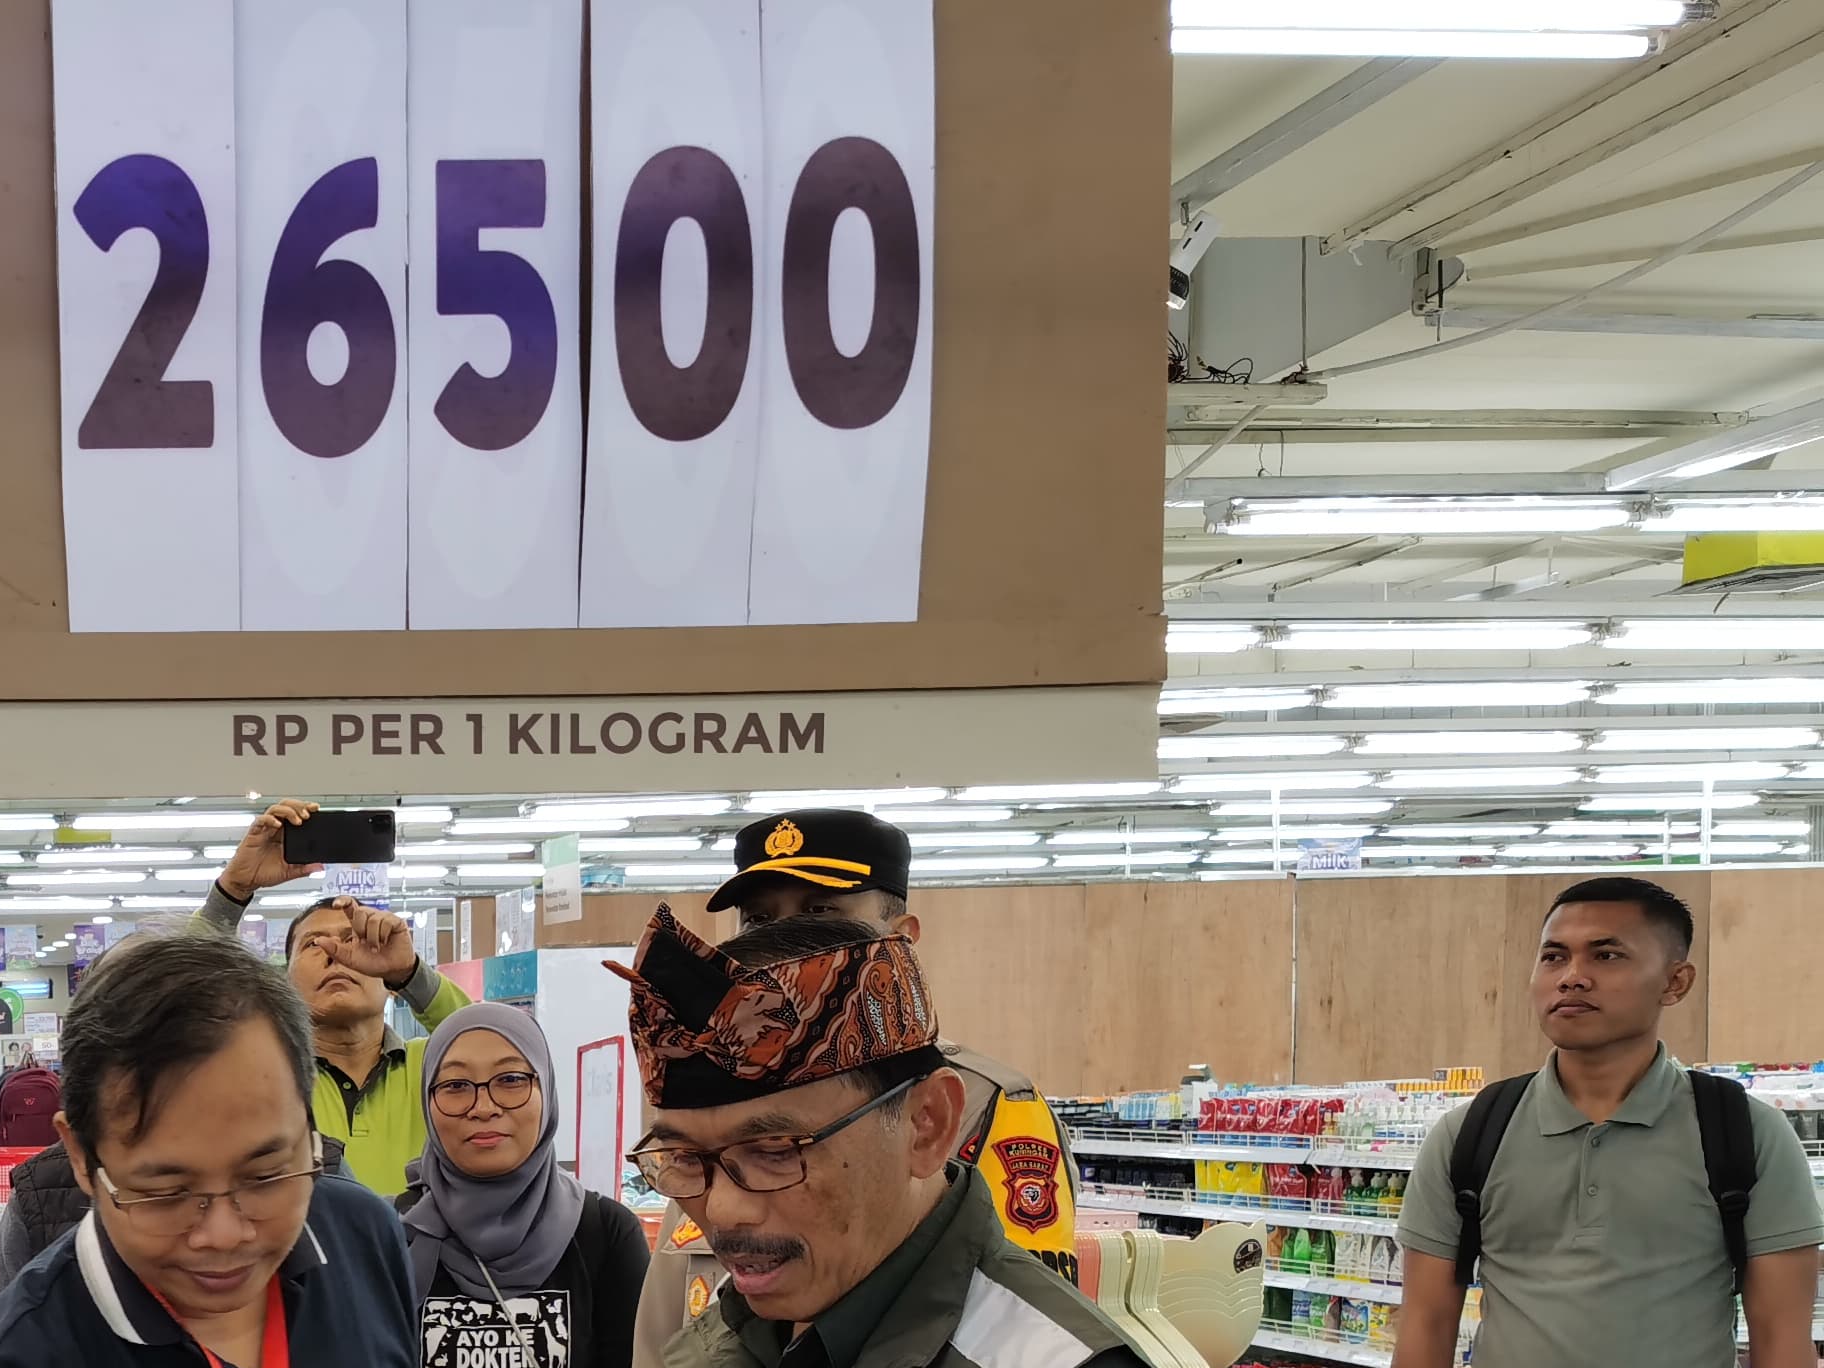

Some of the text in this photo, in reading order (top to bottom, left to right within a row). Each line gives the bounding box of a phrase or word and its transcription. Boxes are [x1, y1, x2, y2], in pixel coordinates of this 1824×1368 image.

[72, 135, 921, 458] 26500
[232, 711, 825, 757] RP PER 1 KILOGRAM
[337, 871, 375, 886] Milk
[1011, 1143, 1049, 1151] POLRES
[456, 1328, 535, 1347] AYO KE
